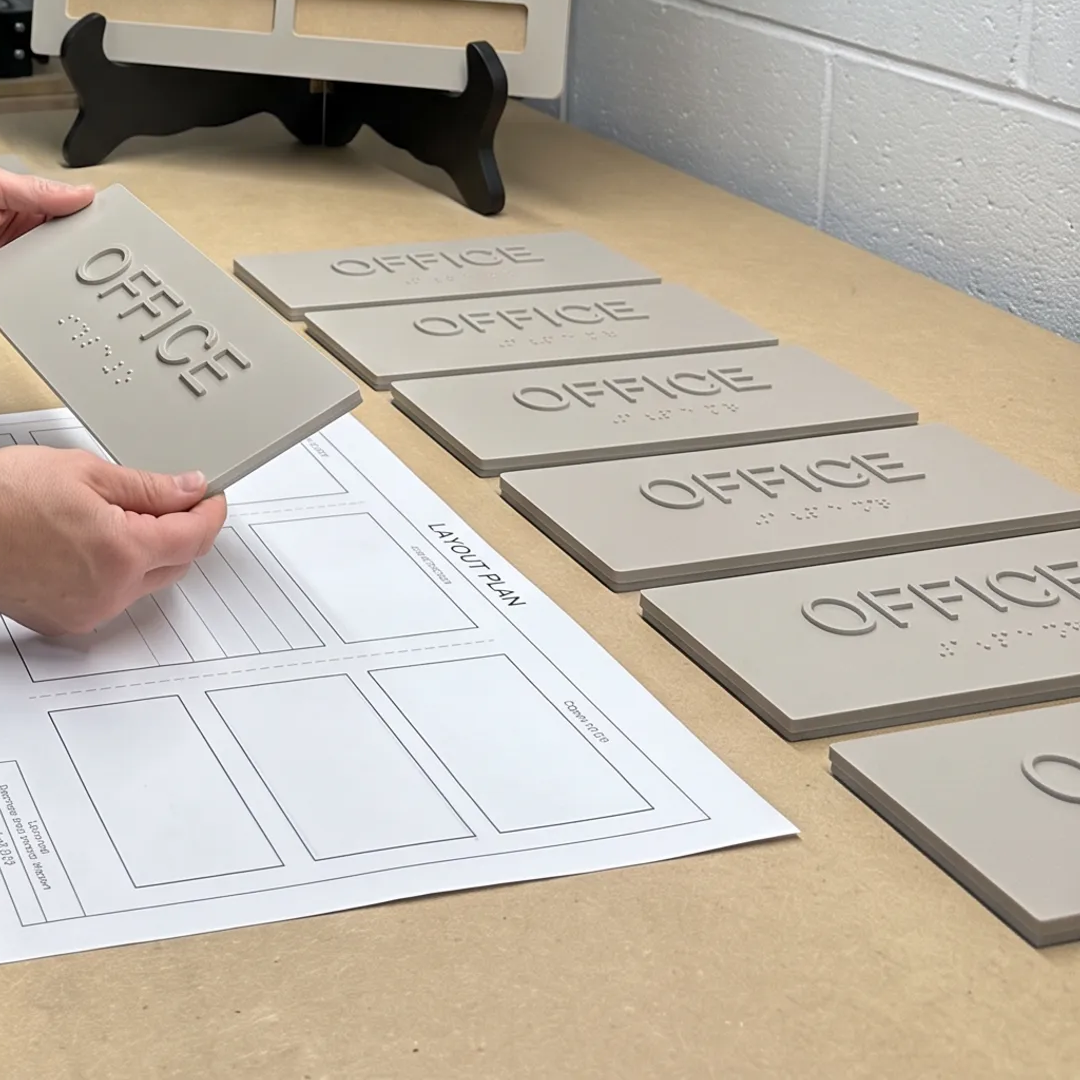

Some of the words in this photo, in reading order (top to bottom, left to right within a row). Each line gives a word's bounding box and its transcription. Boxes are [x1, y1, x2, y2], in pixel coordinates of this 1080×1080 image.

[330, 245, 545, 277] OFFICE
[76, 242, 252, 398] OFFICE
[412, 300, 651, 337] OFFICE
[512, 366, 773, 412] OFFICE
[639, 451, 926, 510] OFFICE
[427, 522, 491, 570] LAYOUT
[477, 572, 527, 607] PLAN
